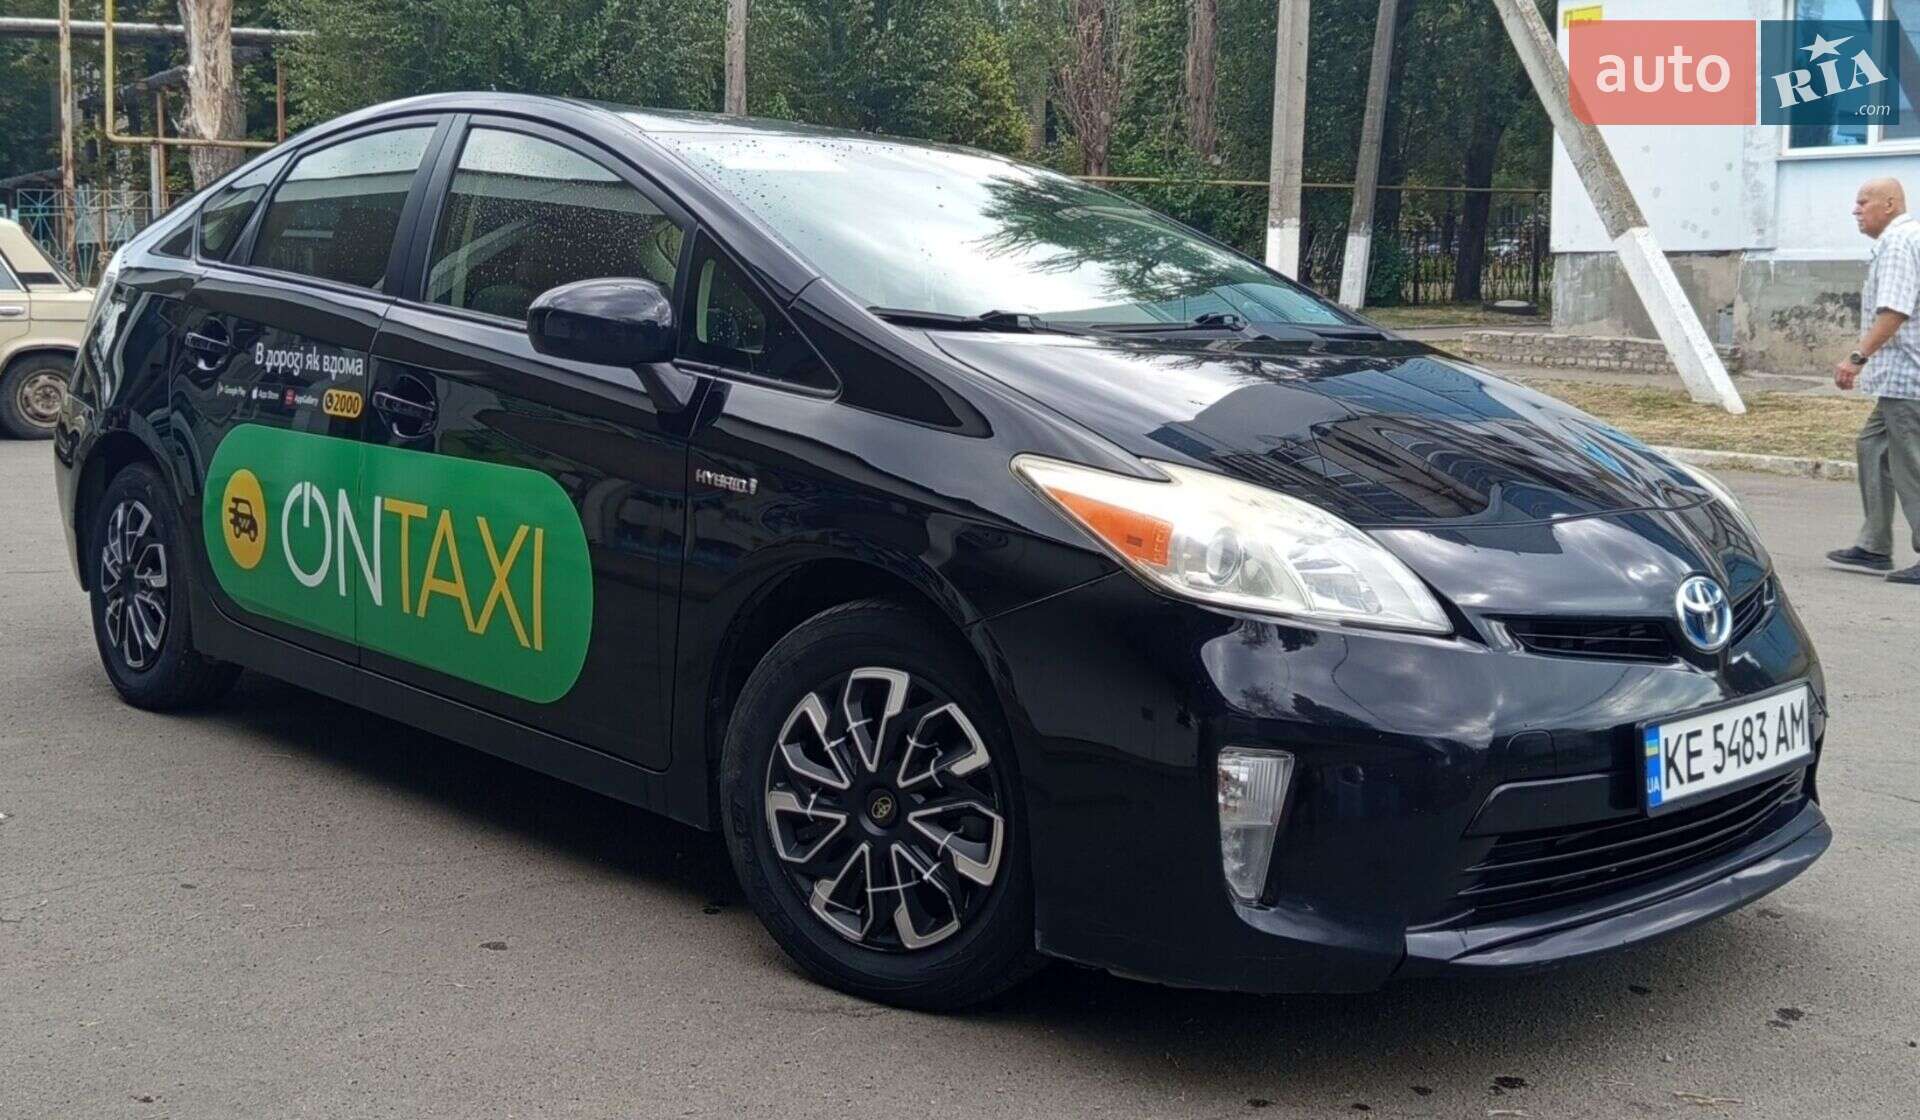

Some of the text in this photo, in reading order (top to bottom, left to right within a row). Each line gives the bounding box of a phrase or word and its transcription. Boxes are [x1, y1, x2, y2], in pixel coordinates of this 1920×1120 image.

[255, 342, 363, 380] В дорозі як вдома
[334, 393, 359, 414] 2000
[281, 481, 543, 651] ONTAXI
[1664, 698, 1805, 789] KE 5483 AM
[1647, 777, 1660, 793] UA
